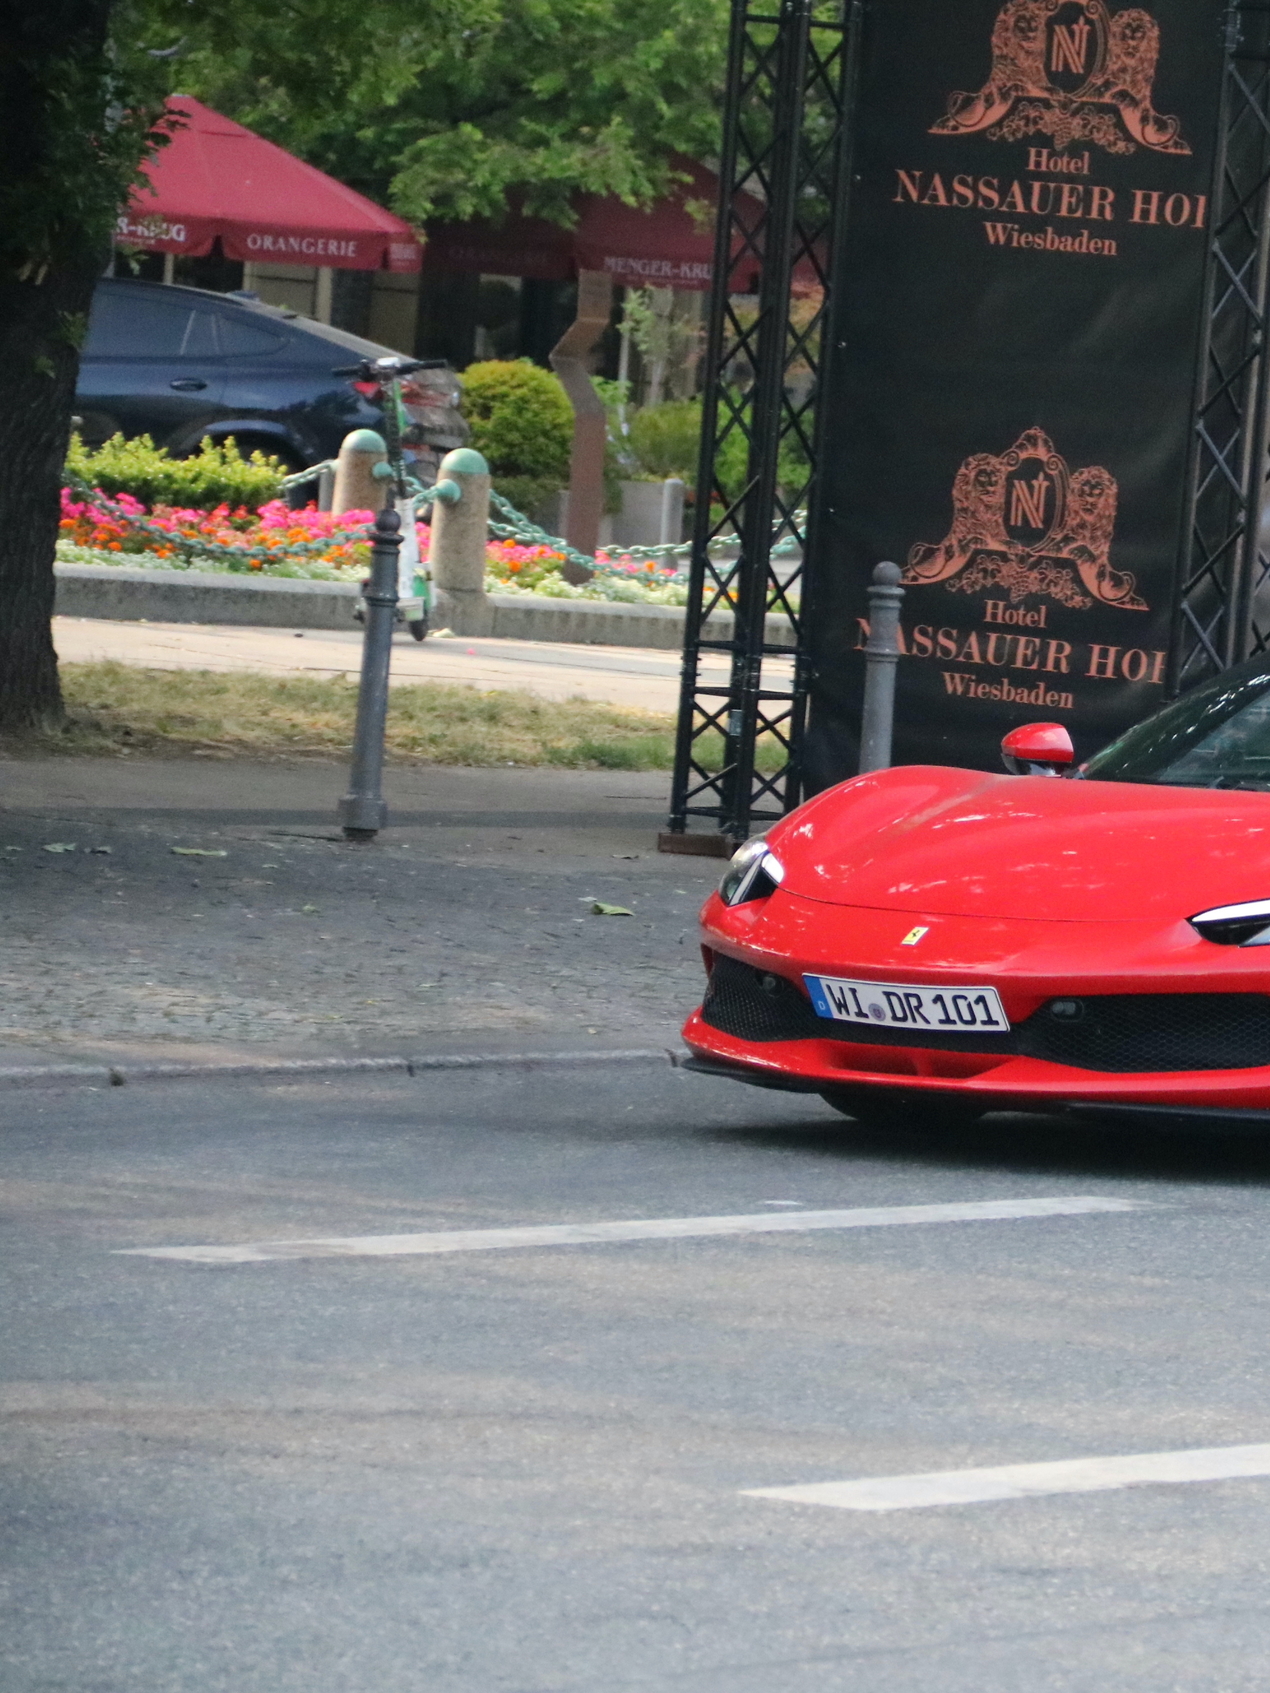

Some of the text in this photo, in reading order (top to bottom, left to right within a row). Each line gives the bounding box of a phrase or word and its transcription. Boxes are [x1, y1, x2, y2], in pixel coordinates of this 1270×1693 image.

[1026, 147, 1091, 175] Hotel
[892, 169, 1116, 221] NASSAUER
[246, 233, 358, 258] ORANGERIE
[983, 221, 1118, 256] Wiesbaden
[604, 256, 716, 280] MENGER-KRU
[984, 599, 1048, 629] Hotel
[941, 672, 1075, 709] Wiesbaden
[825, 983, 1000, 1026] WI DR 101
